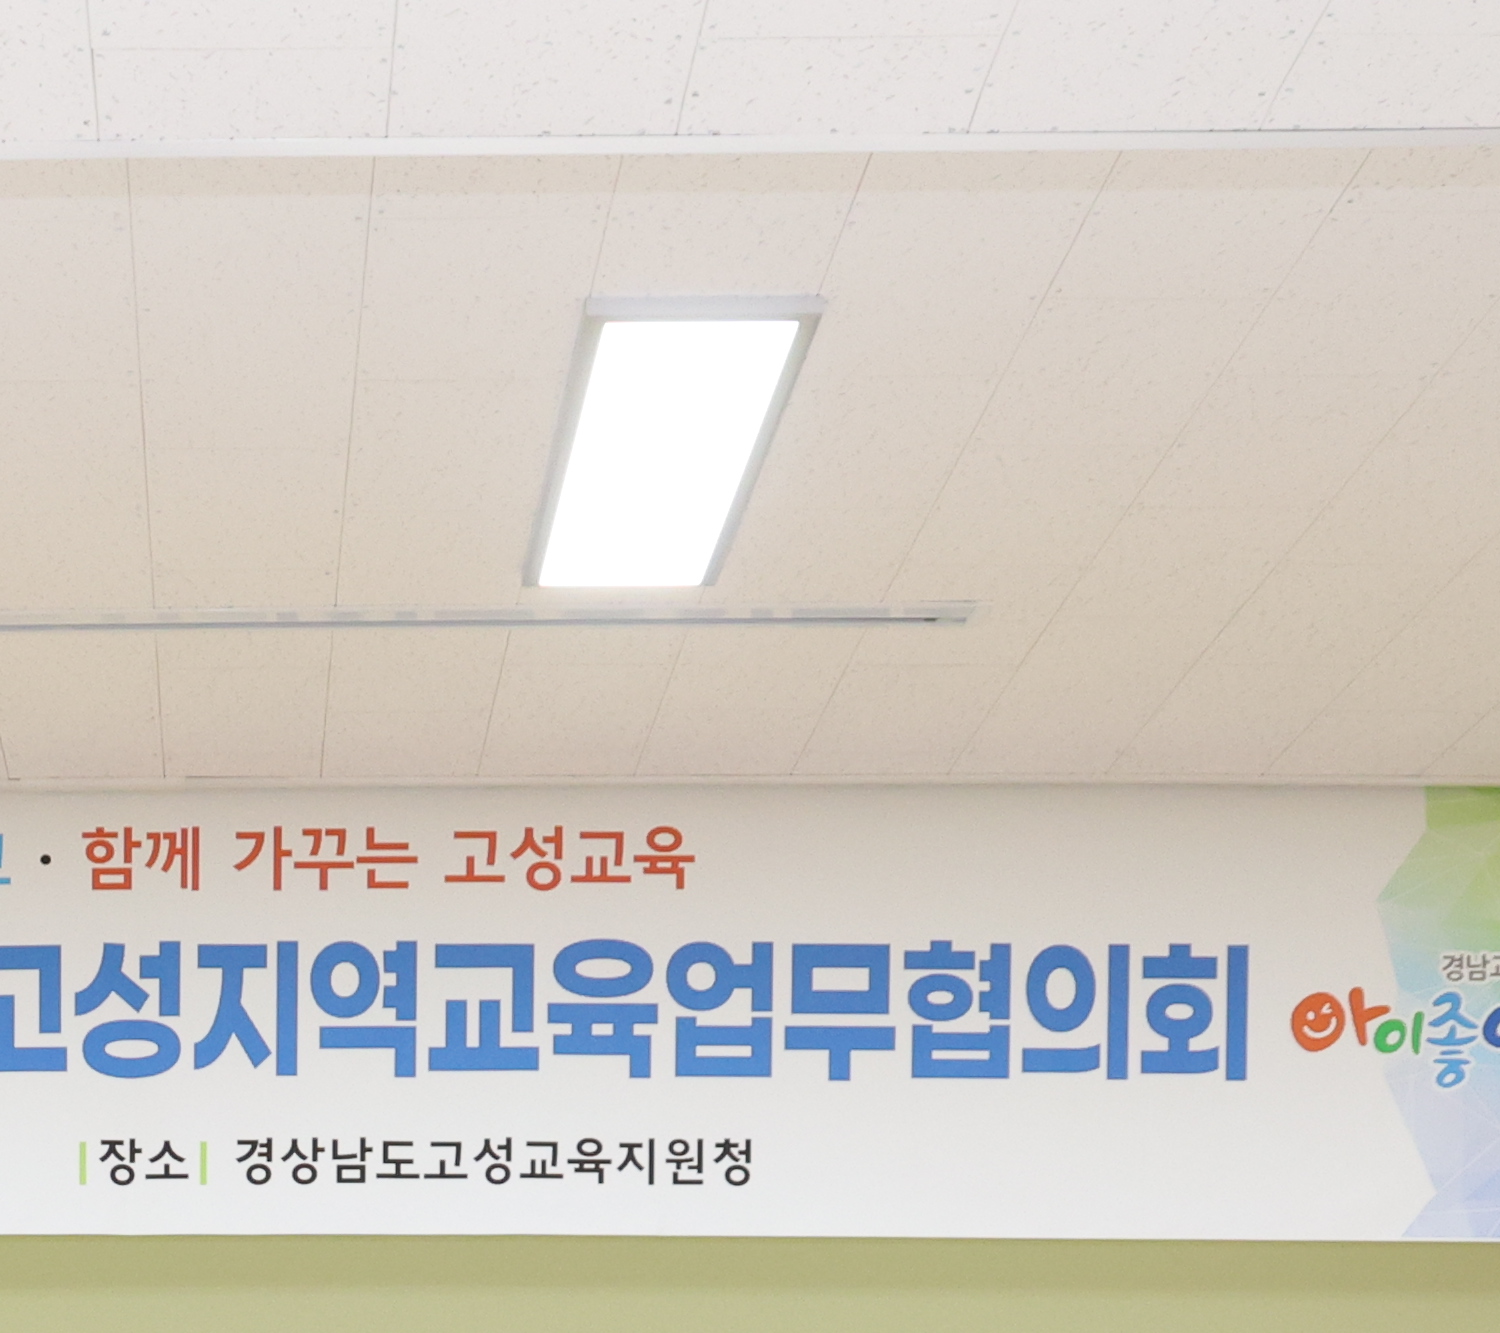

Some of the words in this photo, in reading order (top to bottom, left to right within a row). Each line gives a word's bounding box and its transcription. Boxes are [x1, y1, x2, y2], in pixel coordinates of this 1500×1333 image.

[81, 825, 202, 892] 함께
[233, 825, 420, 892] 가꾸는
[443, 823, 697, 893] 고성교육
[98, 1137, 190, 1189] 장소
[235, 1136, 753, 1188] 경상남도고성교육지원청
